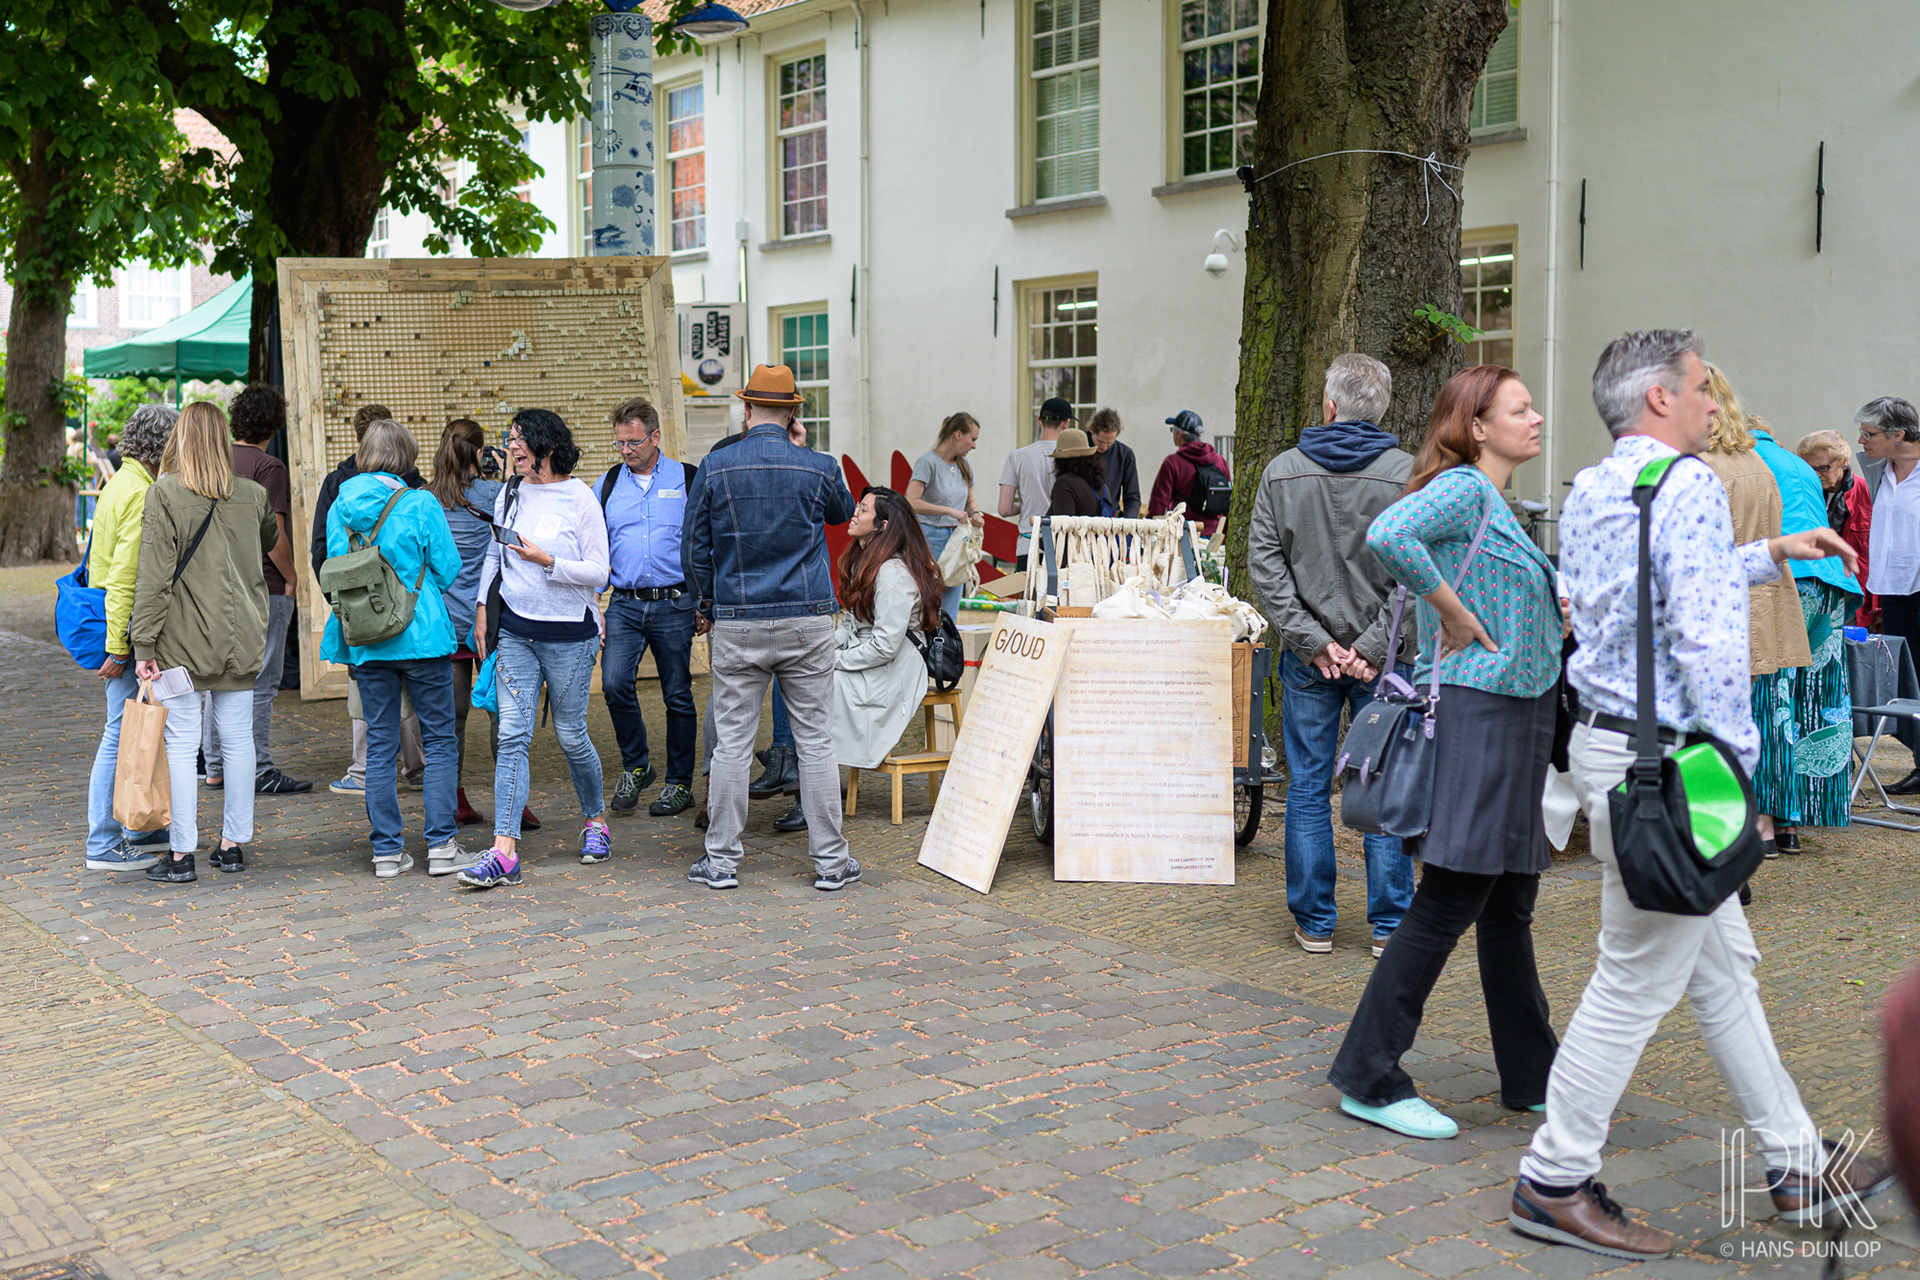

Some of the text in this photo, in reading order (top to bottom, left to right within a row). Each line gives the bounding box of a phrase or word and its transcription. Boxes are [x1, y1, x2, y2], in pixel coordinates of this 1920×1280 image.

[692, 325, 702, 352] MOJO
[708, 313, 717, 339] BACK
[719, 317, 728, 349] STAGE
[994, 628, 1046, 660] G/OUD
